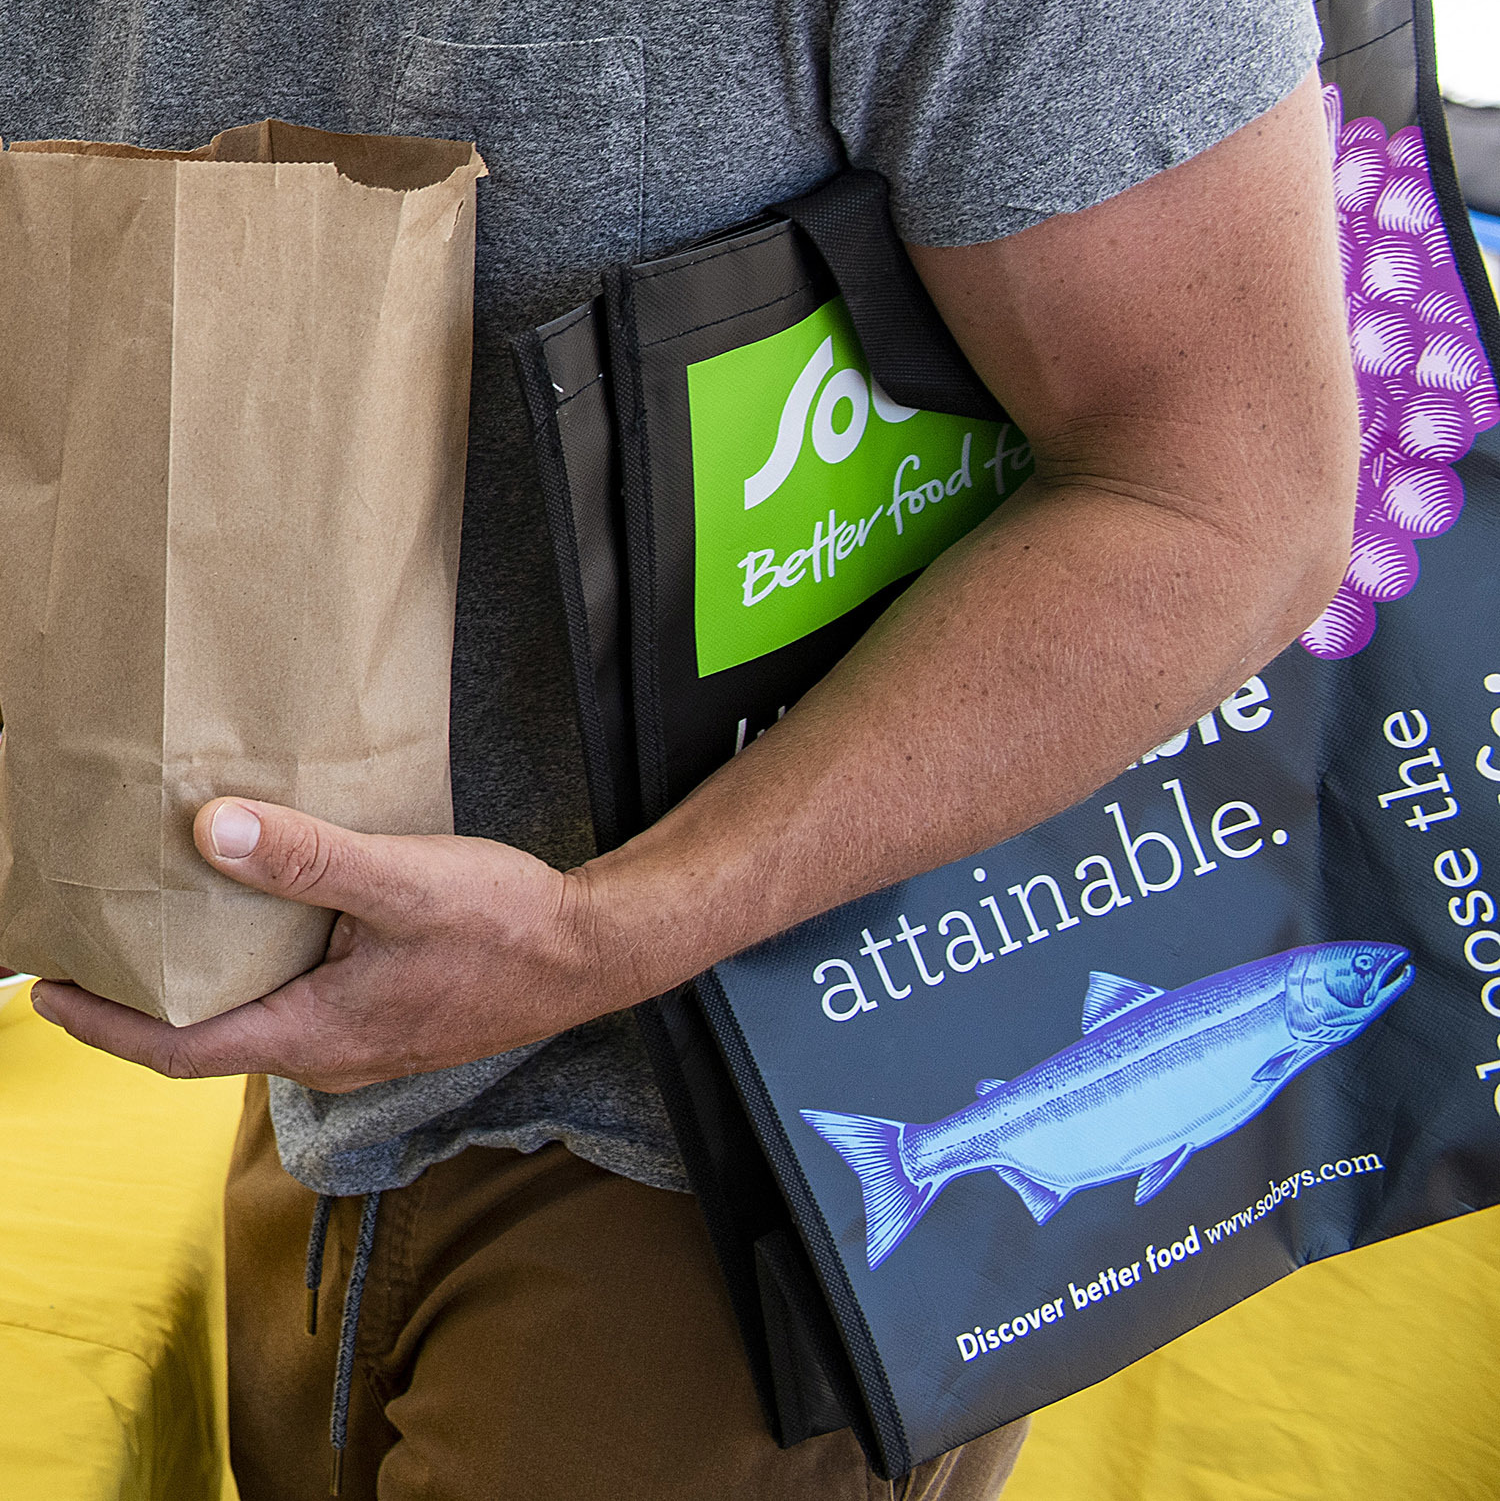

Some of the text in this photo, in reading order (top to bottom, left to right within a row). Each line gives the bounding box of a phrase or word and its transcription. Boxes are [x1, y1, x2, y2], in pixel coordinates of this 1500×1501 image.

[736, 508, 884, 608] Better
[886, 432, 973, 536] food
[1376, 708, 1462, 832] the
[813, 778, 1290, 1023] attainable.
[955, 1150, 1385, 1363] Discover better food www.sobeys.com
